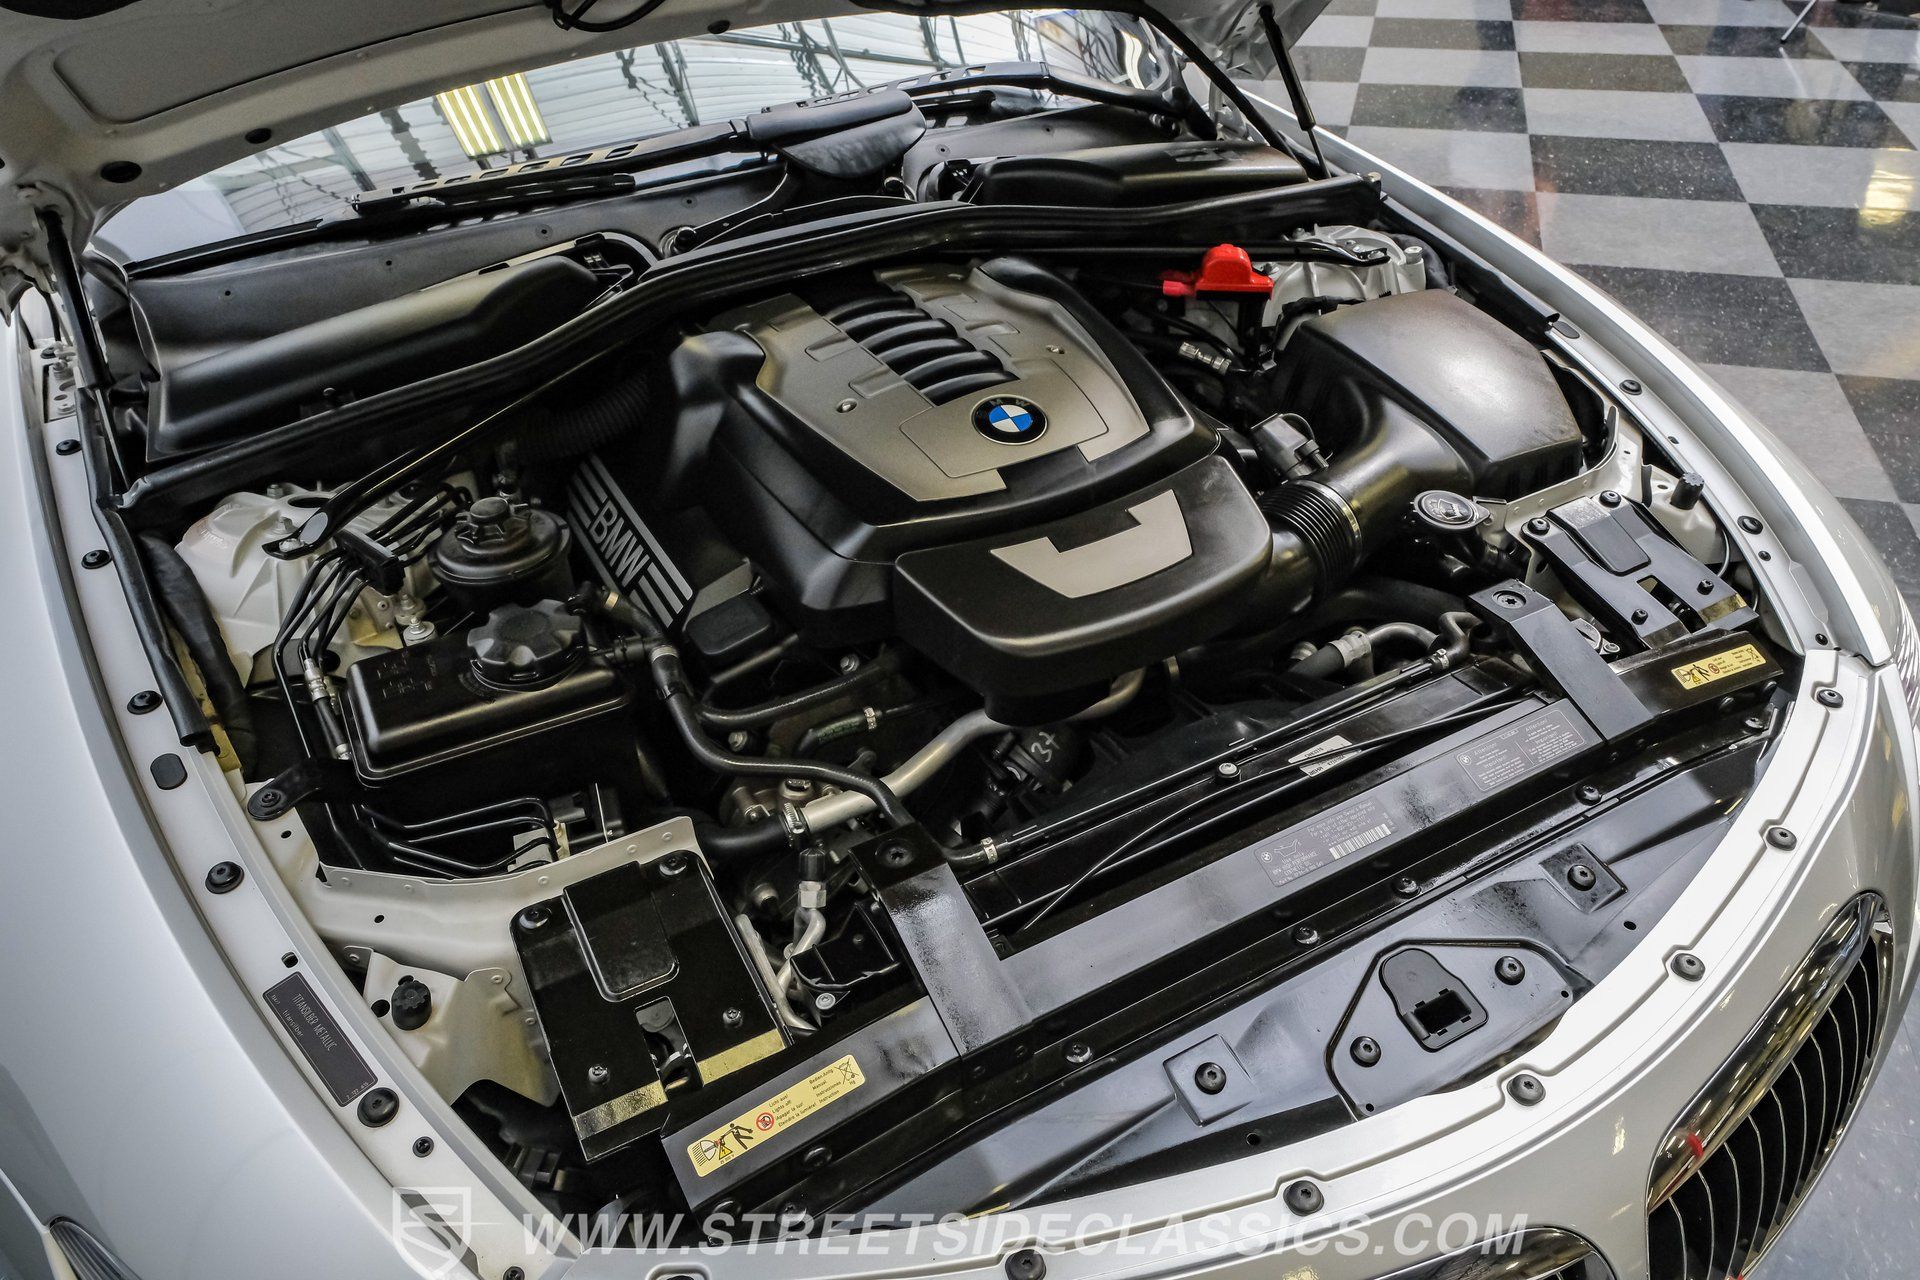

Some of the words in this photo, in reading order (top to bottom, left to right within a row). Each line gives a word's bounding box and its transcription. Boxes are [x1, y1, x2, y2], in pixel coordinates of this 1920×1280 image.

[589, 500, 650, 588] BMW
[282, 1009, 304, 1037] titansilber
[292, 993, 318, 1026] TITANSILBER
[314, 1023, 337, 1051] METALLIC
[812, 1080, 827, 1090] Manual
